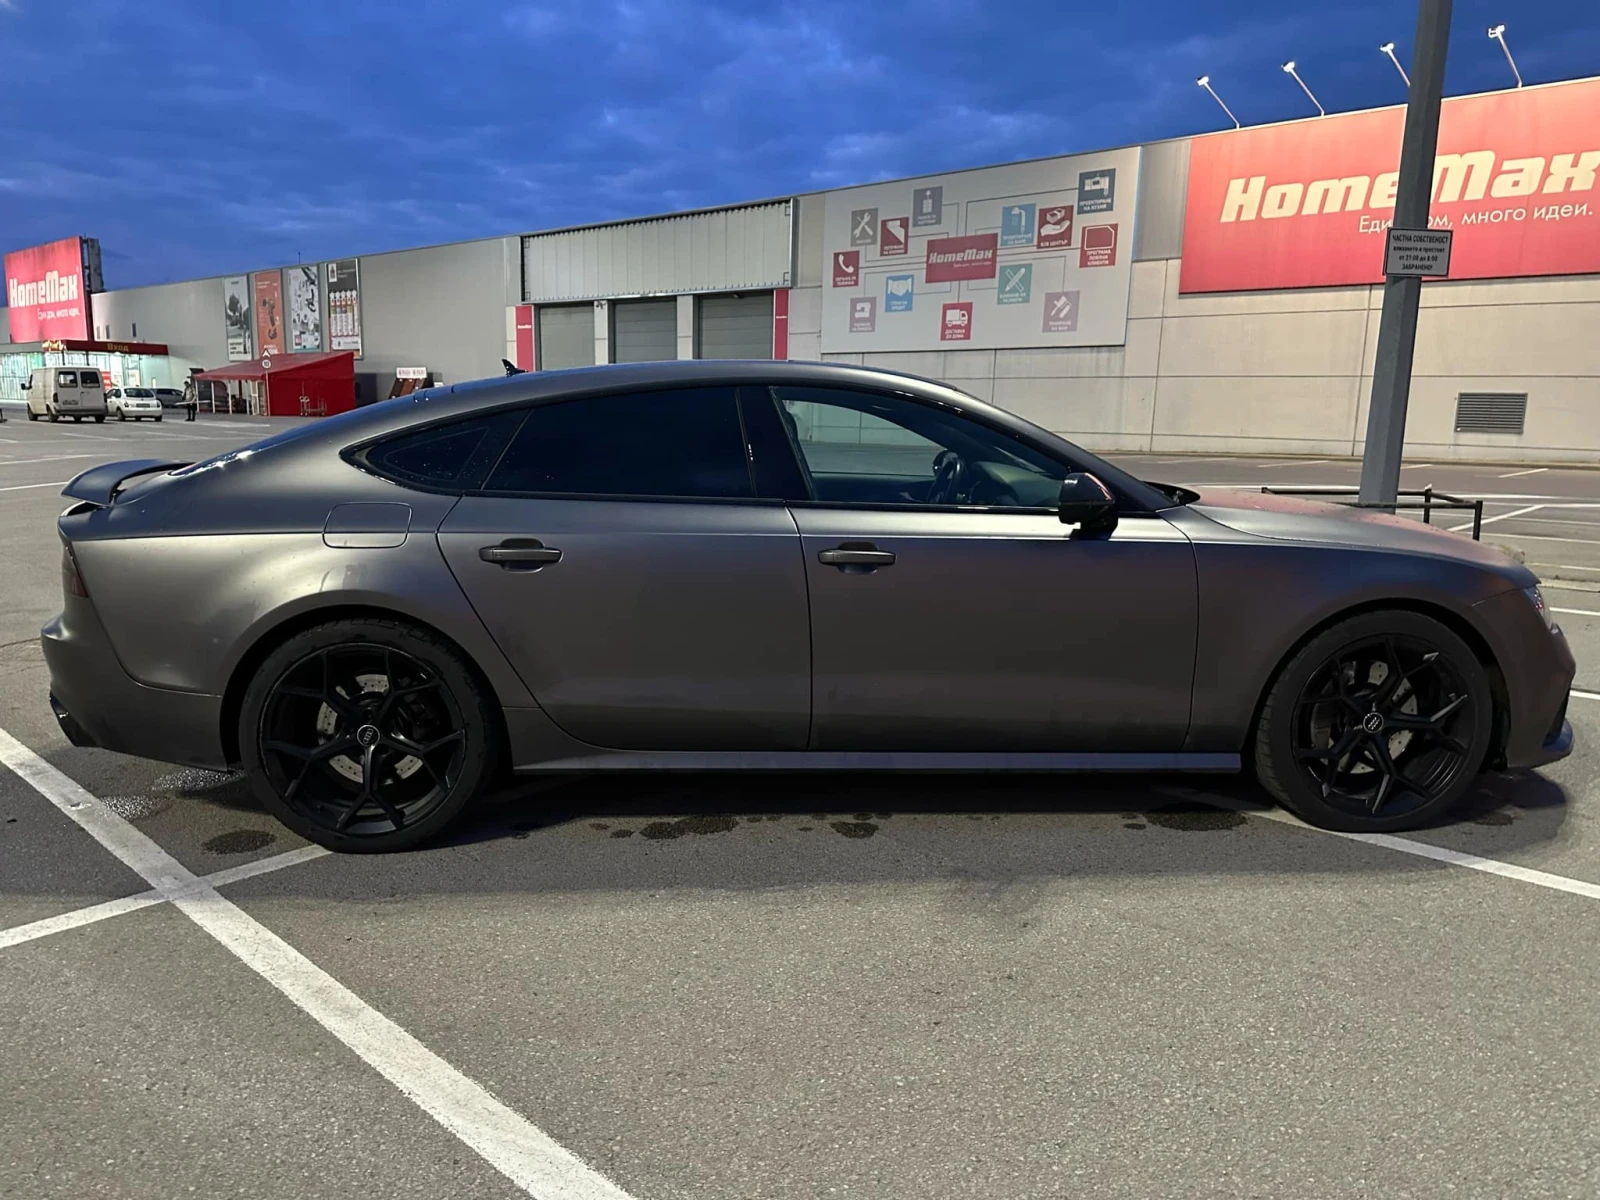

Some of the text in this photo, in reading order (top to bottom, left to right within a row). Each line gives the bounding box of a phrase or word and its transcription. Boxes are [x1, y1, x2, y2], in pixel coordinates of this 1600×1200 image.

[1220, 150, 1600, 222] HomeMax
[1359, 215, 1393, 234] Еди
[1461, 208, 1526, 225] много
[1533, 203, 1593, 221] идеи.
[1392, 234, 1449, 244] ЧАСТНА СОБСТВЕНОСТ
[929, 249, 993, 264] HomeMax
[9, 271, 78, 308] HomeMax
[107, 343, 129, 352] Вход
